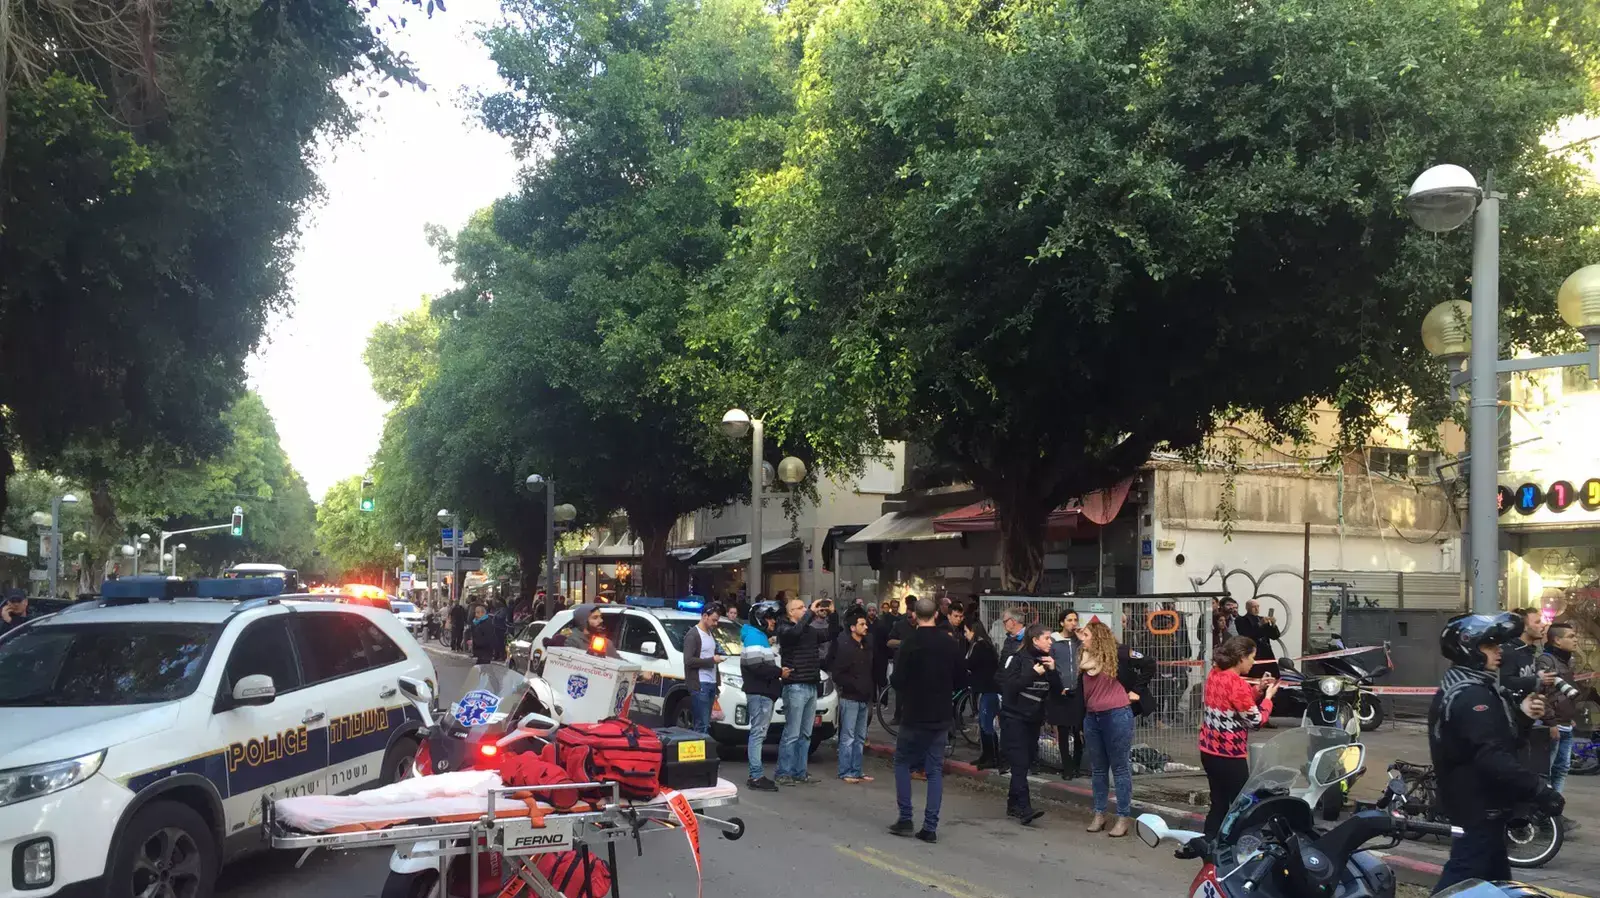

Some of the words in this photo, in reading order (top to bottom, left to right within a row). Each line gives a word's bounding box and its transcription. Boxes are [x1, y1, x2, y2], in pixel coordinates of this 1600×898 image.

[330, 706, 389, 744] משטרה
[229, 725, 308, 772] POLICE
[331, 763, 368, 786] משטרת
[284, 780, 320, 799] ישראל
[514, 834, 564, 847] FERNO
